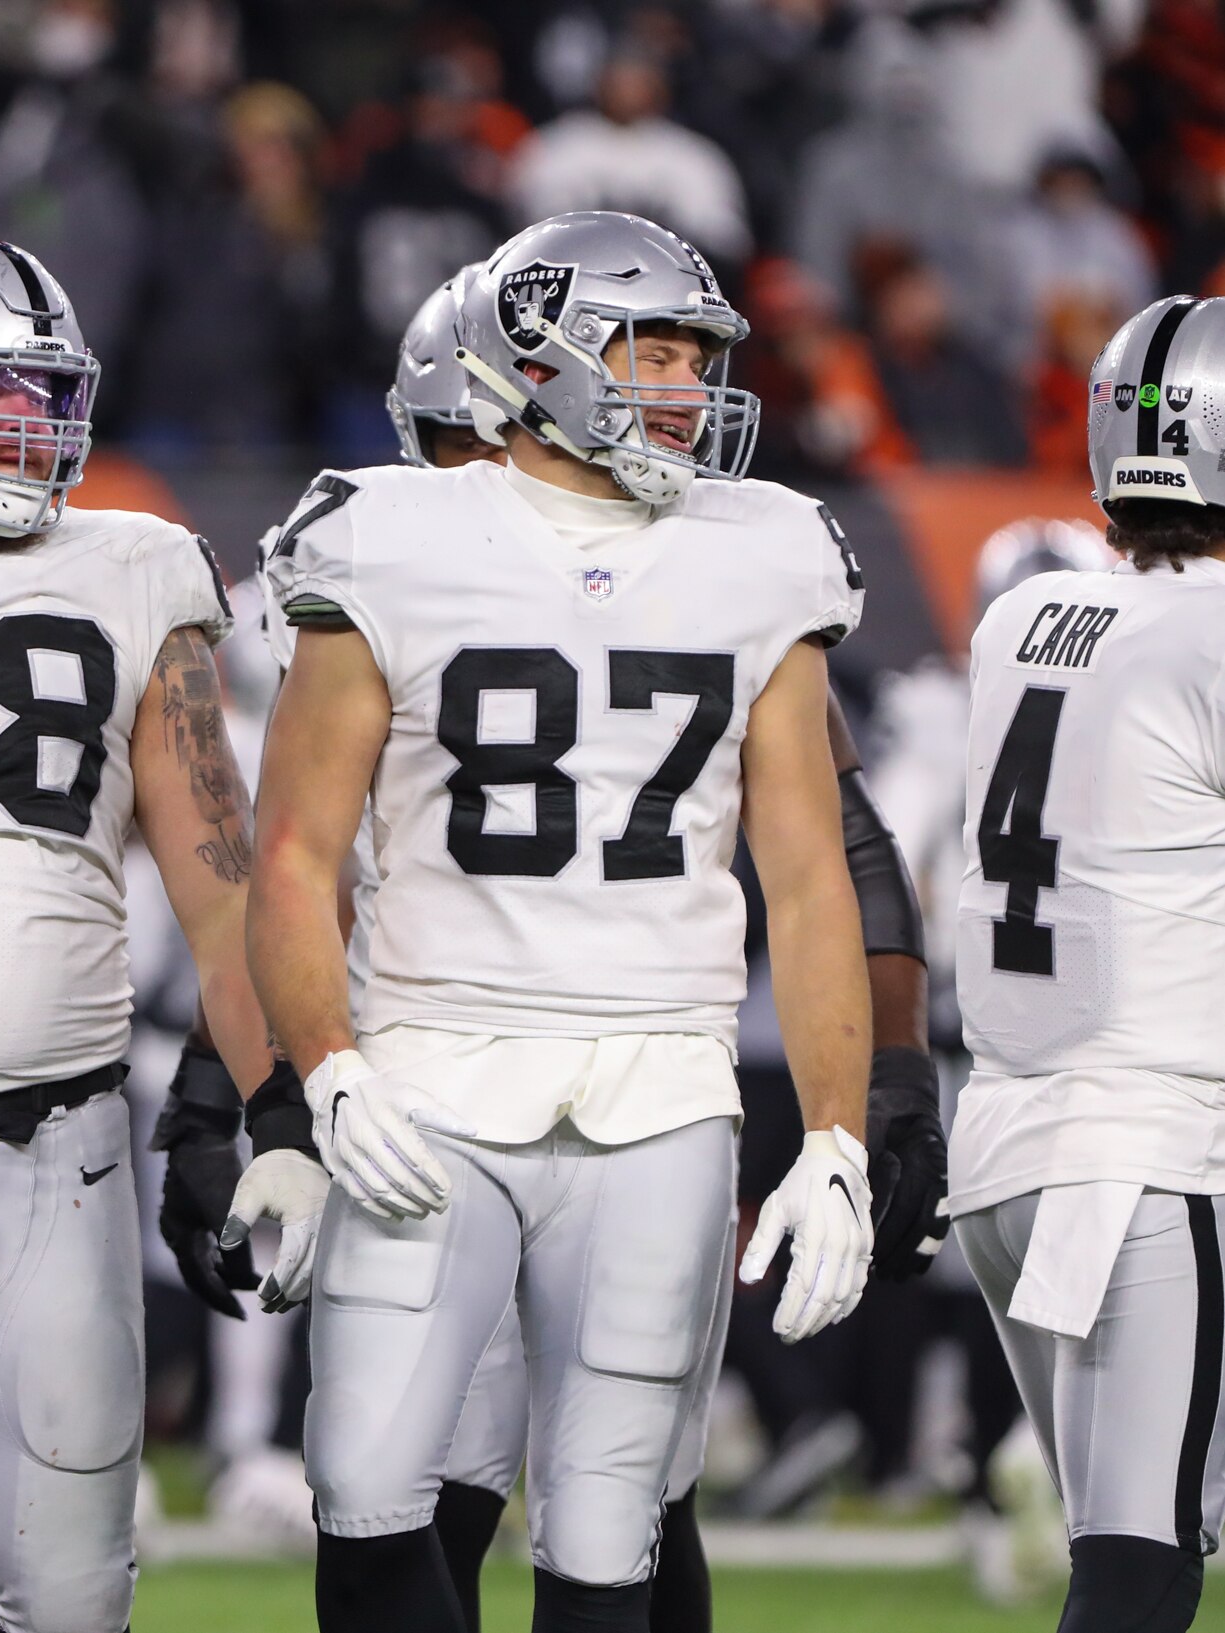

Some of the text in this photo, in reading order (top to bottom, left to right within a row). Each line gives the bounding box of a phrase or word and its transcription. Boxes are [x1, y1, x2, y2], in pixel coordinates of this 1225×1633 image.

[506, 269, 566, 285] RAIDERS
[1115, 388, 1134, 402] JM
[1168, 388, 1189, 403] AL
[1161, 419, 1189, 456] 4
[1116, 470, 1187, 488] RAIDERS
[1016, 602, 1118, 668] CARR
[435, 643, 740, 885] 87
[977, 683, 1070, 980] 4
